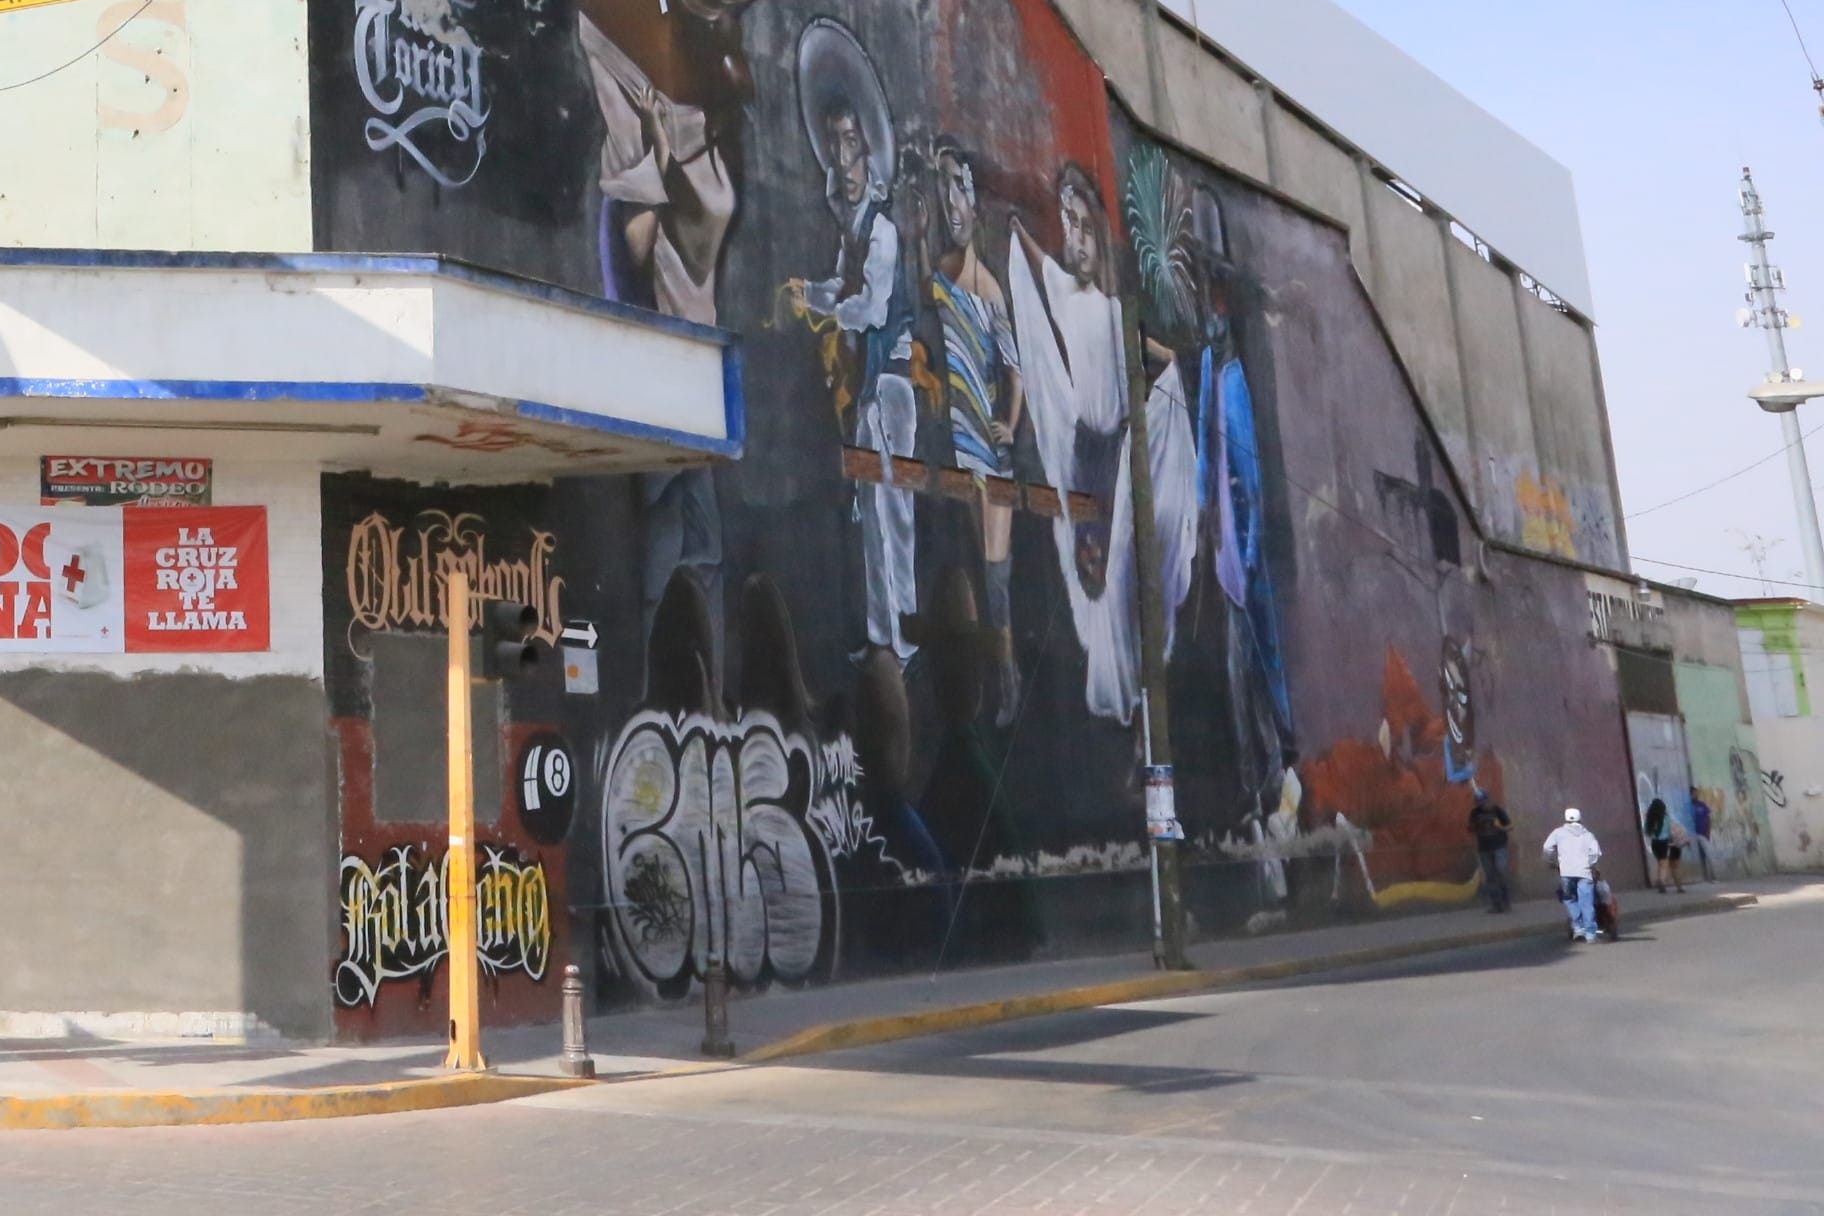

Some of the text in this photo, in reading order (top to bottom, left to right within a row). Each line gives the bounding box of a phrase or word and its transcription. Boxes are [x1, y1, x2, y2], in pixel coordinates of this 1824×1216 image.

[49, 458, 205, 481] EXTREMO
[110, 480, 205, 496] RODEO
[178, 527, 214, 546] LA
[155, 547, 238, 567] CRUZ
[156, 567, 238, 595] ROJA
[179, 591, 215, 610] TE
[147, 612, 247, 631] LLAMA
